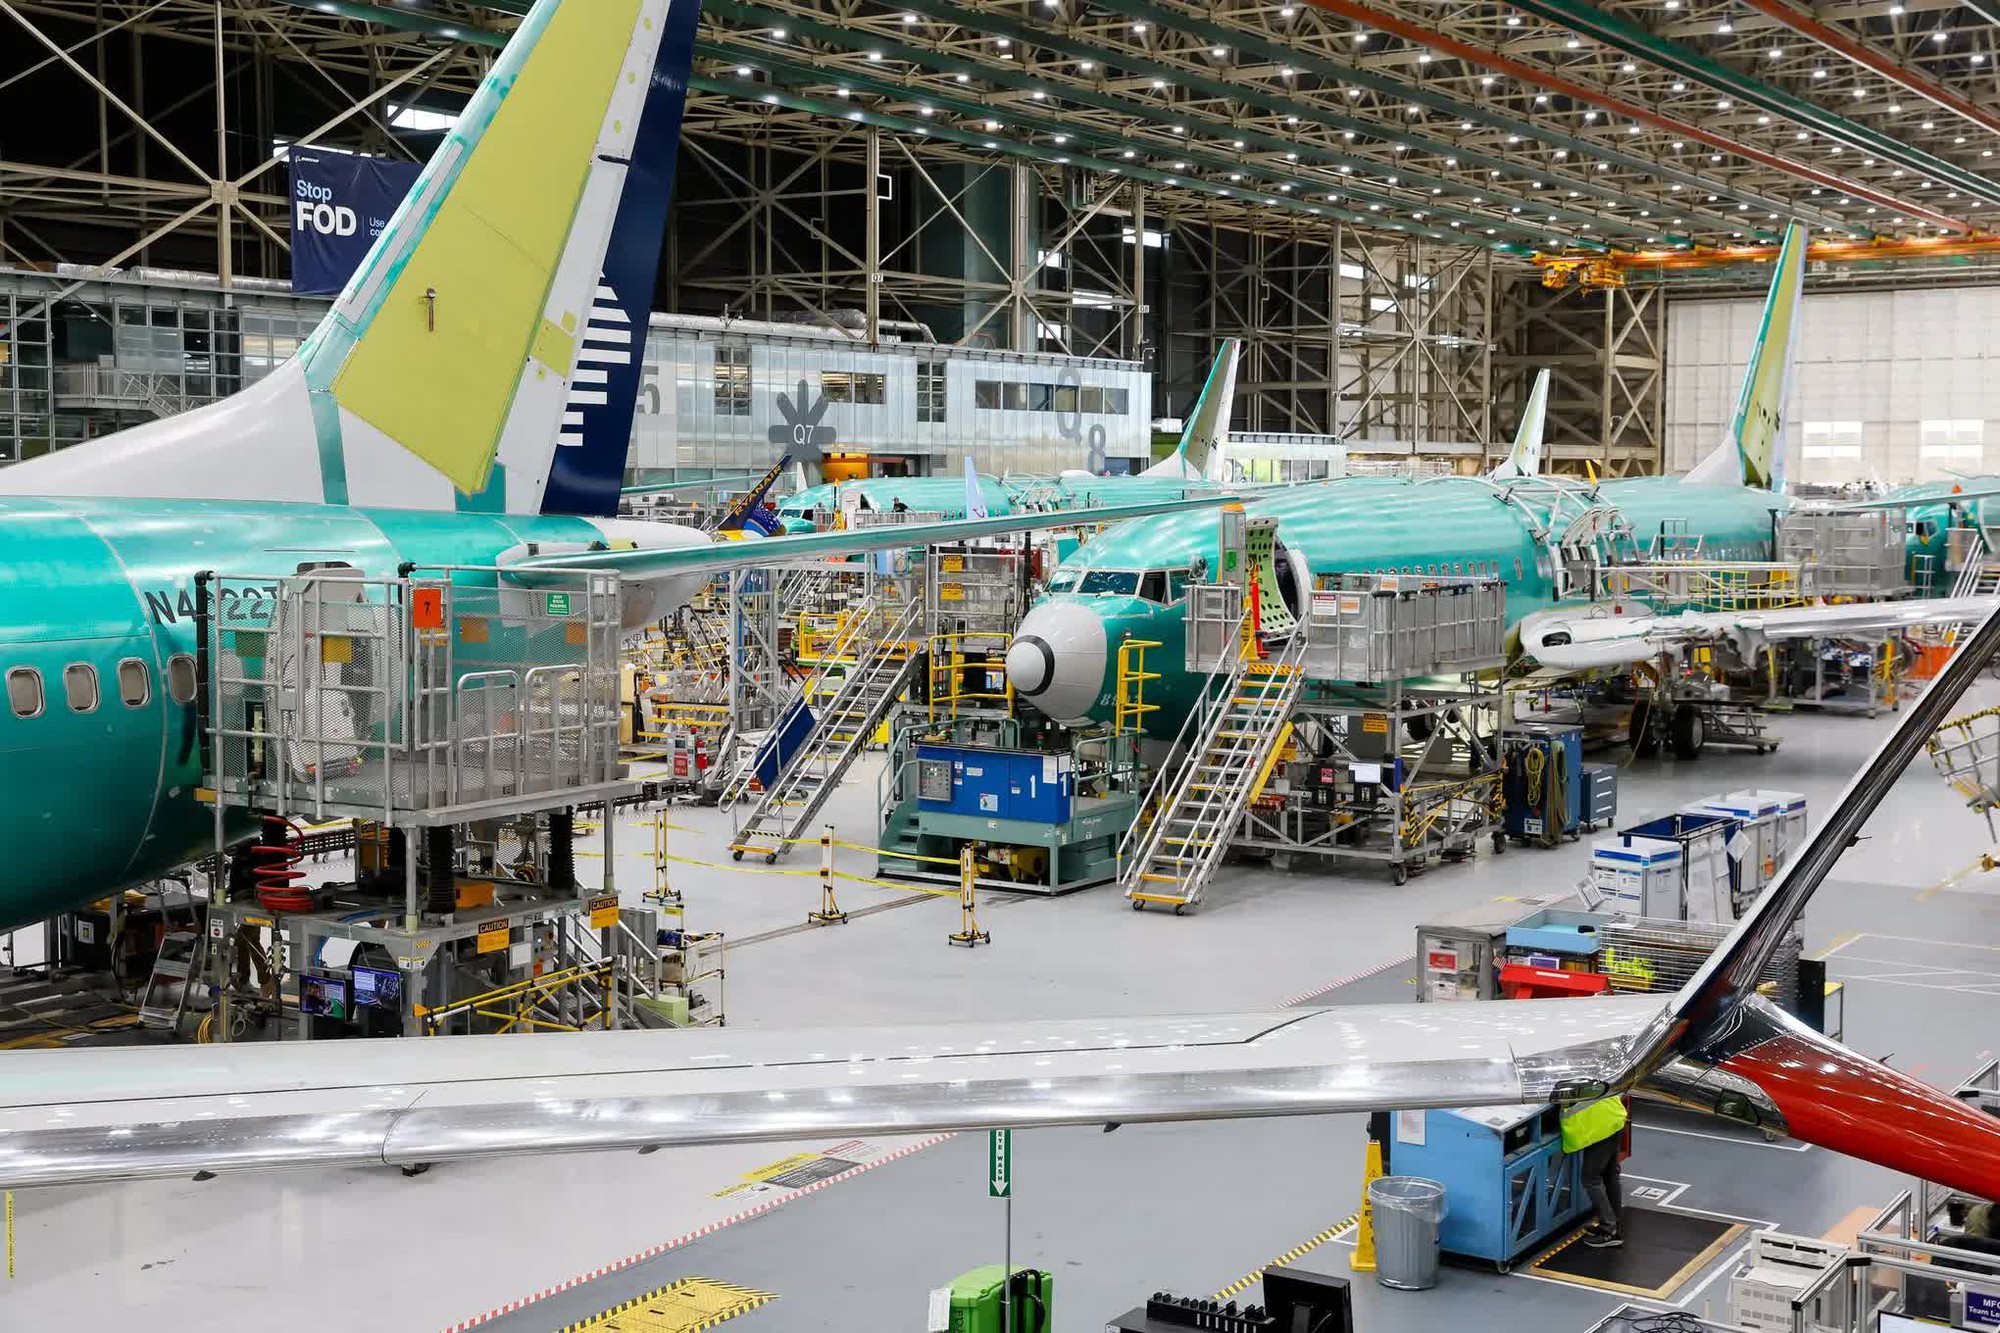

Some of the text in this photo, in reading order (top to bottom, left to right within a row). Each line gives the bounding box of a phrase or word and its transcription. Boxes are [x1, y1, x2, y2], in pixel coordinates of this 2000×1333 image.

[296, 179, 332, 203] Stop
[296, 201, 357, 236] FOD
[369, 217, 385, 228] Use
[369, 228, 383, 236] co
[793, 423, 815, 446] Q7
[734, 464, 784, 517] RYANAIR
[1030, 775, 1036, 798] 1
[1060, 773, 1067, 797] 1
[593, 898, 617, 910] CAUTION
[479, 920, 508, 932] CAUTION
[1968, 1305, 1989, 1316] Team
